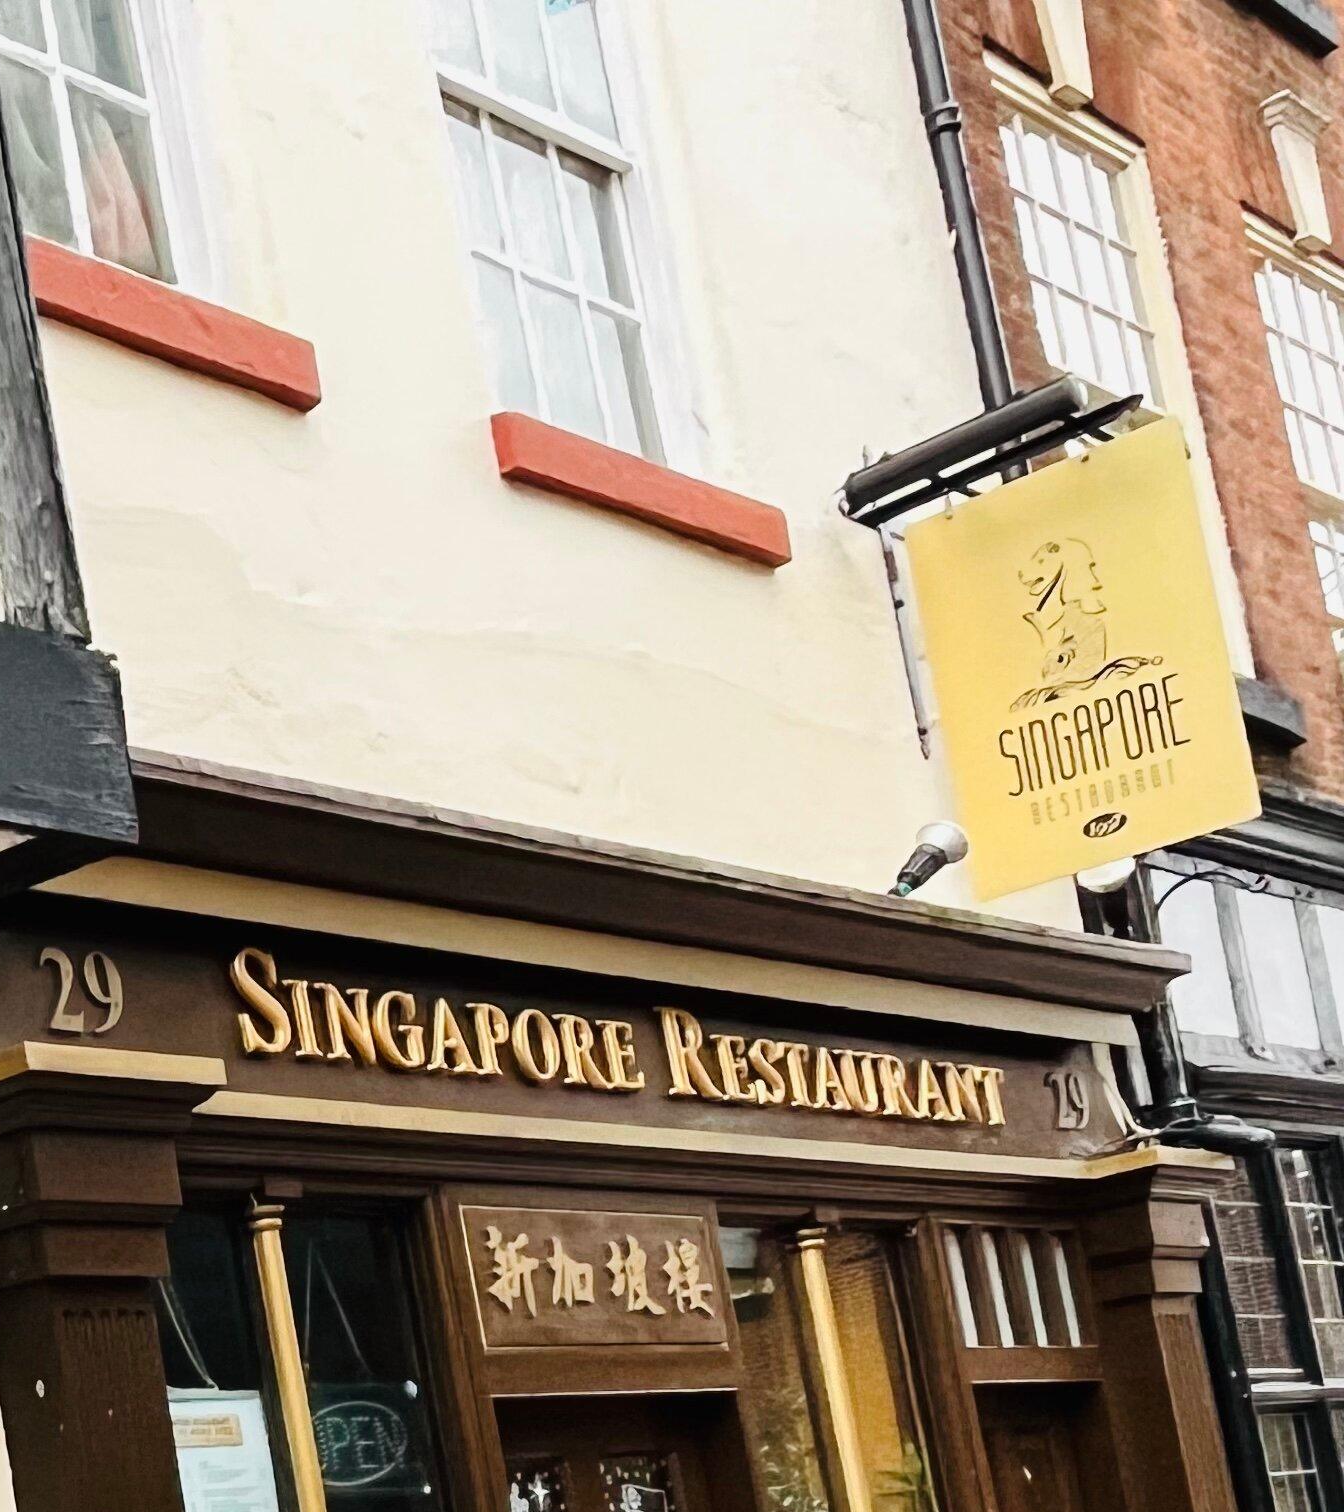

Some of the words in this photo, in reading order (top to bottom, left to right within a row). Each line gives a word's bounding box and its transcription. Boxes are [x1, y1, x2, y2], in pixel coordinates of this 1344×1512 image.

[999, 673, 1191, 797] SINGAPORE
[39, 946, 124, 1034] 29
[230, 946, 646, 1092] SINGAPORE
[653, 1005, 1006, 1127] RESTAURANT
[314, 1415, 408, 1471] PEN
